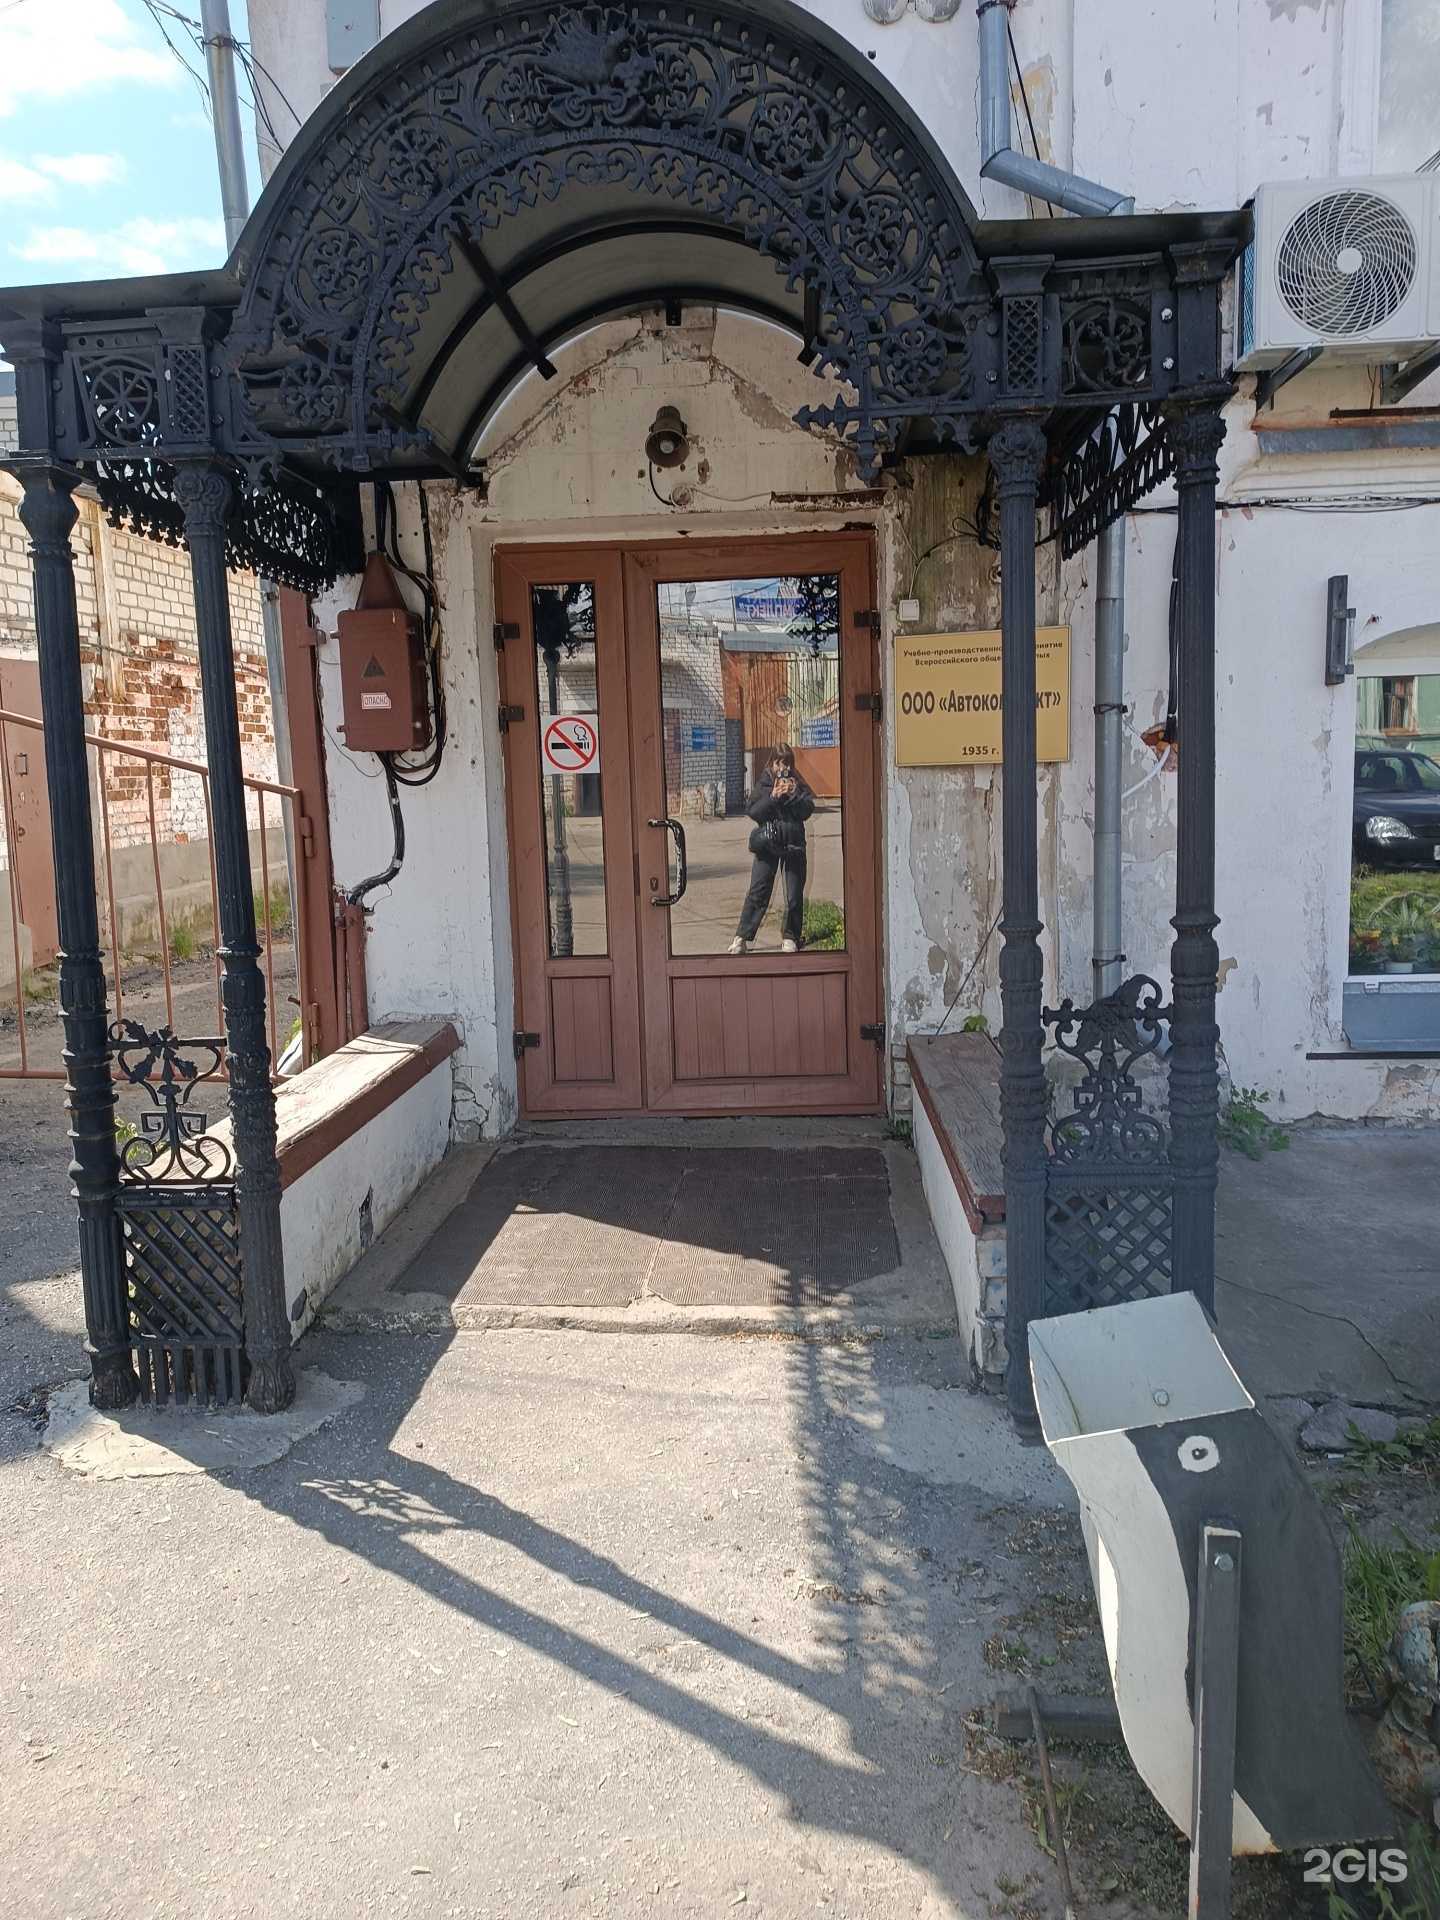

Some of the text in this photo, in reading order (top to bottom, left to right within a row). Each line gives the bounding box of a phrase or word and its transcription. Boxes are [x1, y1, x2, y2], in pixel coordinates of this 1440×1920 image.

[903, 645, 1002, 657] Учебно-производственно
[915, 656, 978, 666] Всероссийского
[902, 690, 935, 715] ООО
[962, 745, 1000, 756] 1935 г.
